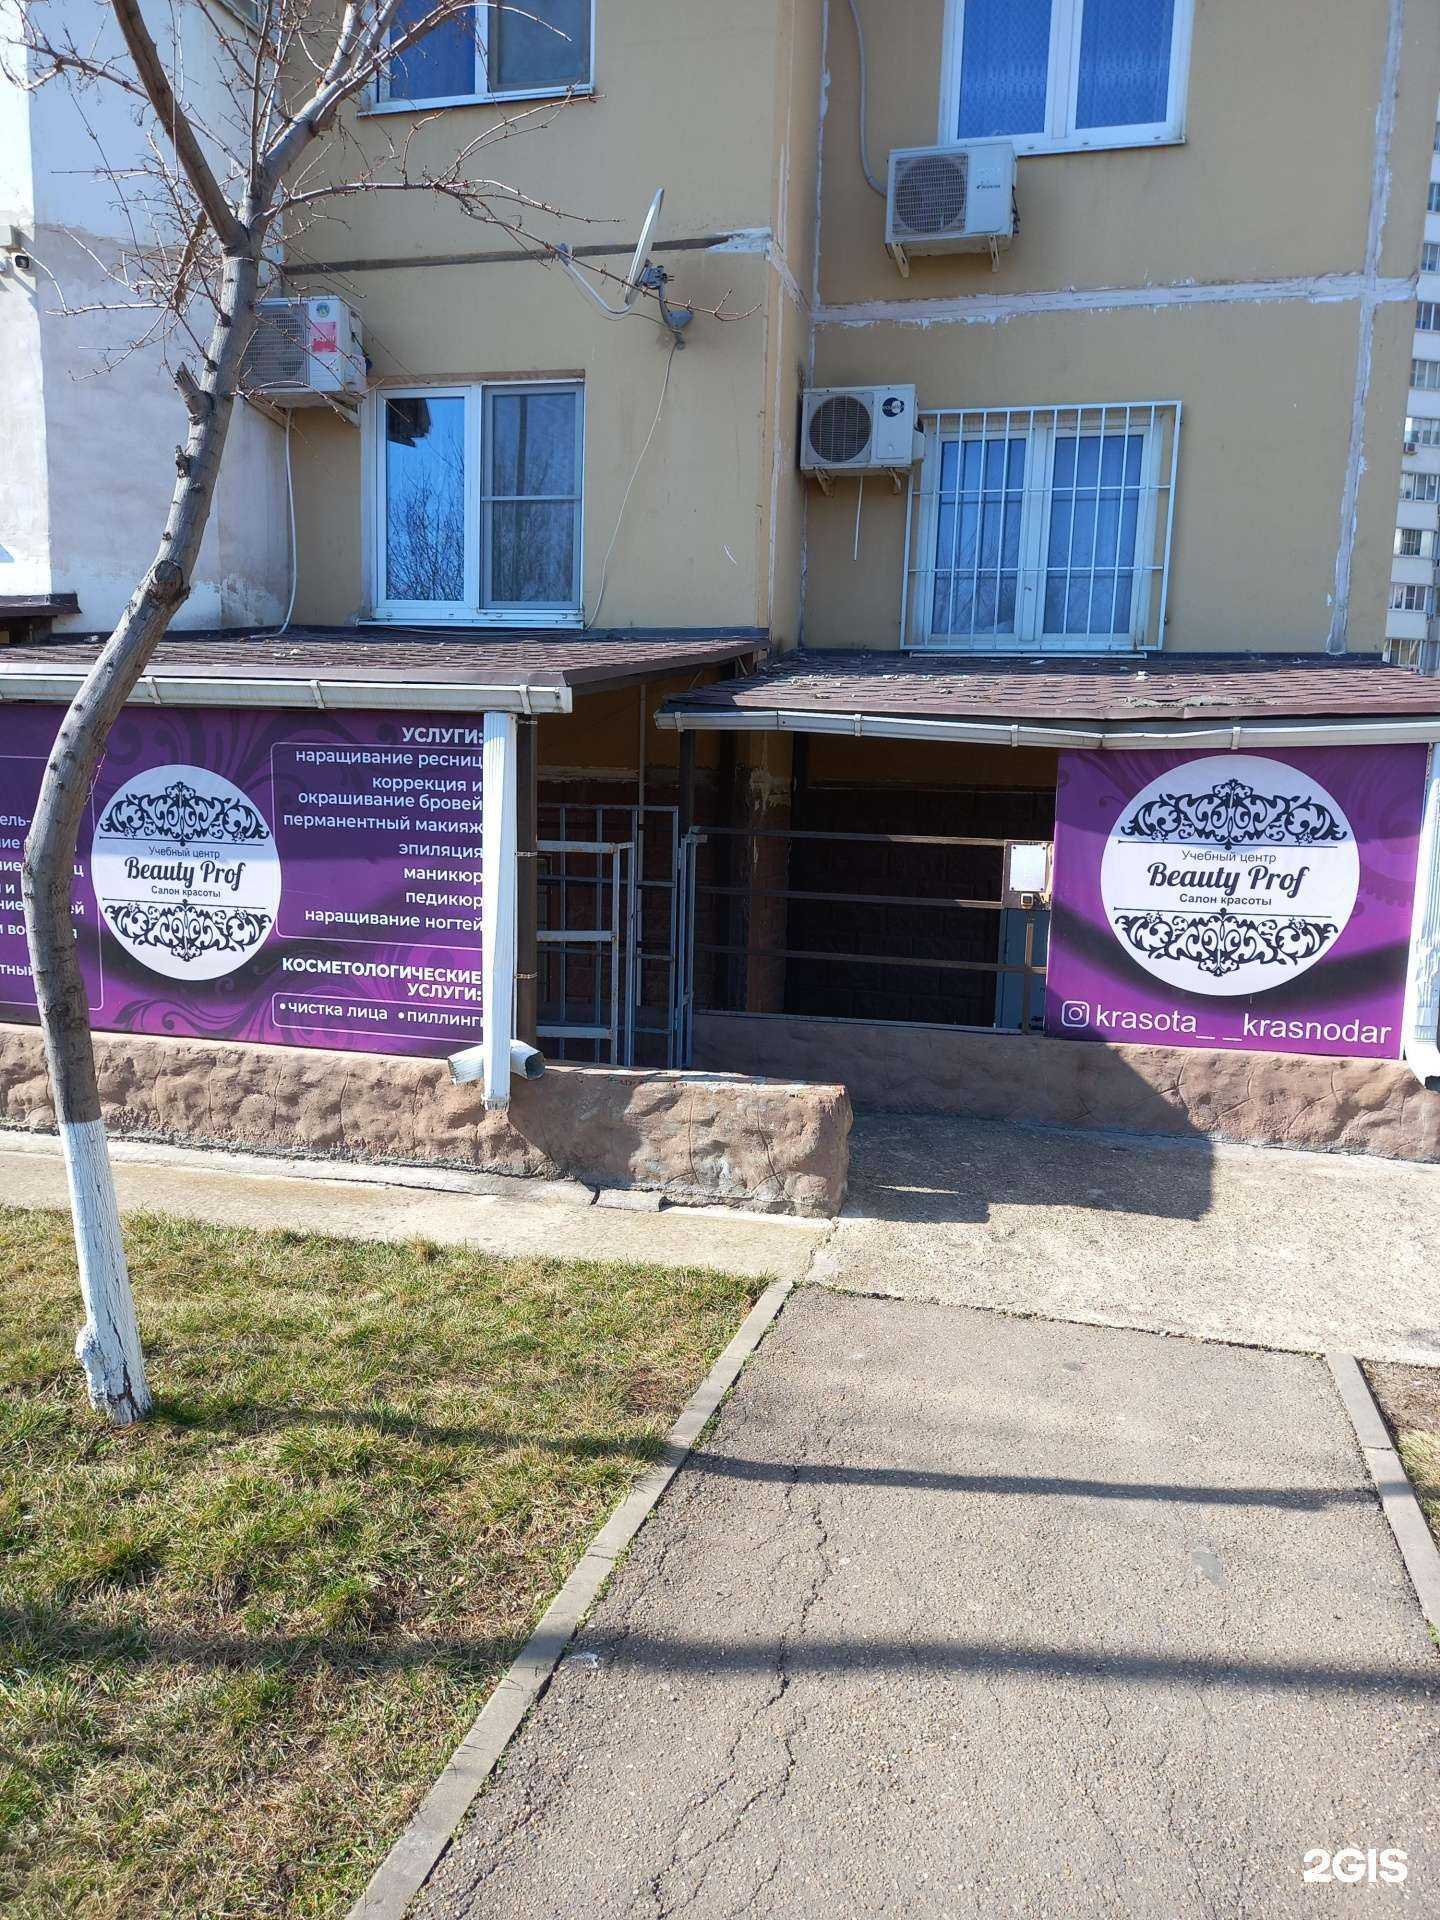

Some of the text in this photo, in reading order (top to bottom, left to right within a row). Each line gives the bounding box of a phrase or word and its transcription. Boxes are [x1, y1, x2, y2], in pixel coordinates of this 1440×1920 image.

[402, 727, 483, 744] УСЛУГИ:
[296, 750, 483, 768] наращивание ресниц
[372, 777, 483, 792] коррекция и
[298, 793, 483, 811] окрашивание бровей
[284, 813, 483, 834] перманентный макияж
[148, 846, 220, 860] Учебный центр
[399, 843, 483, 859] эпиляция
[1181, 848, 1276, 865] Учебный центр
[124, 857, 246, 891] Beauty Prof
[404, 868, 483, 883] маникюр
[1147, 861, 1310, 899] Beauty Prof
[151, 886, 221, 898] Салон красоты
[406, 892, 483, 907] педикюр
[1179, 892, 1272, 907] Салон красоты
[305, 909, 483, 931] наращивание ногтей
[282, 957, 482, 984] КОСМЕТОЛОГИЧЕСКИЕ
[407, 983, 482, 1001] УСЛУГИ:
[347, 1006, 388, 1020] лица
